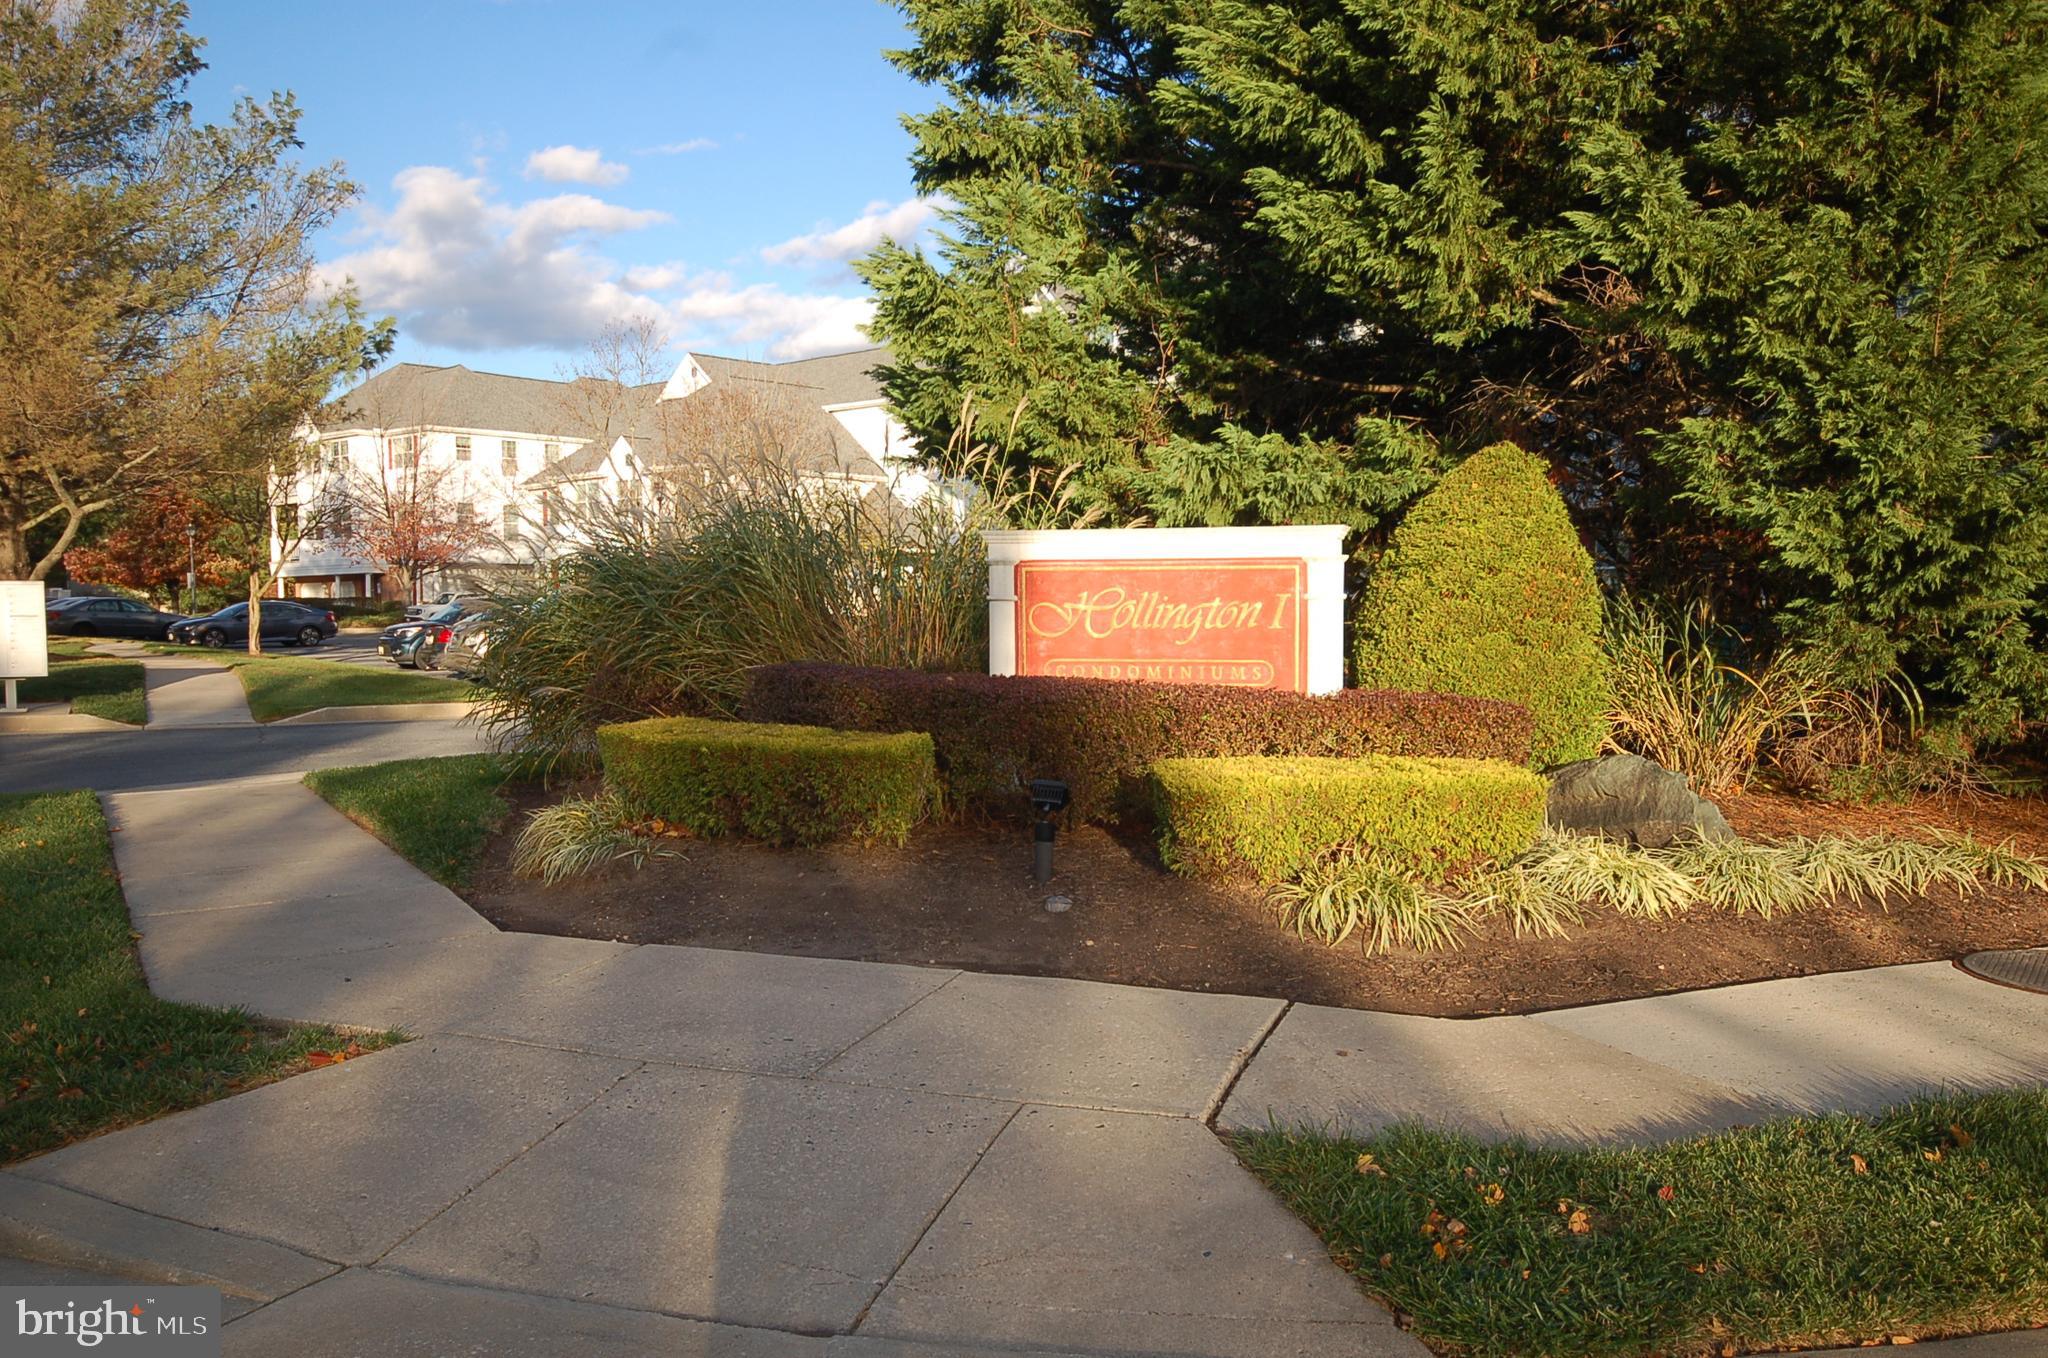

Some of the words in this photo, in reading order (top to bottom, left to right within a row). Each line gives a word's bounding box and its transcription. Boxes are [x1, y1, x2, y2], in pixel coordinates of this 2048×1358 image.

[1028, 587, 1262, 645] Hollington
[1268, 592, 1292, 630] I
[1055, 664, 1263, 681] CONDOMINIUMS
